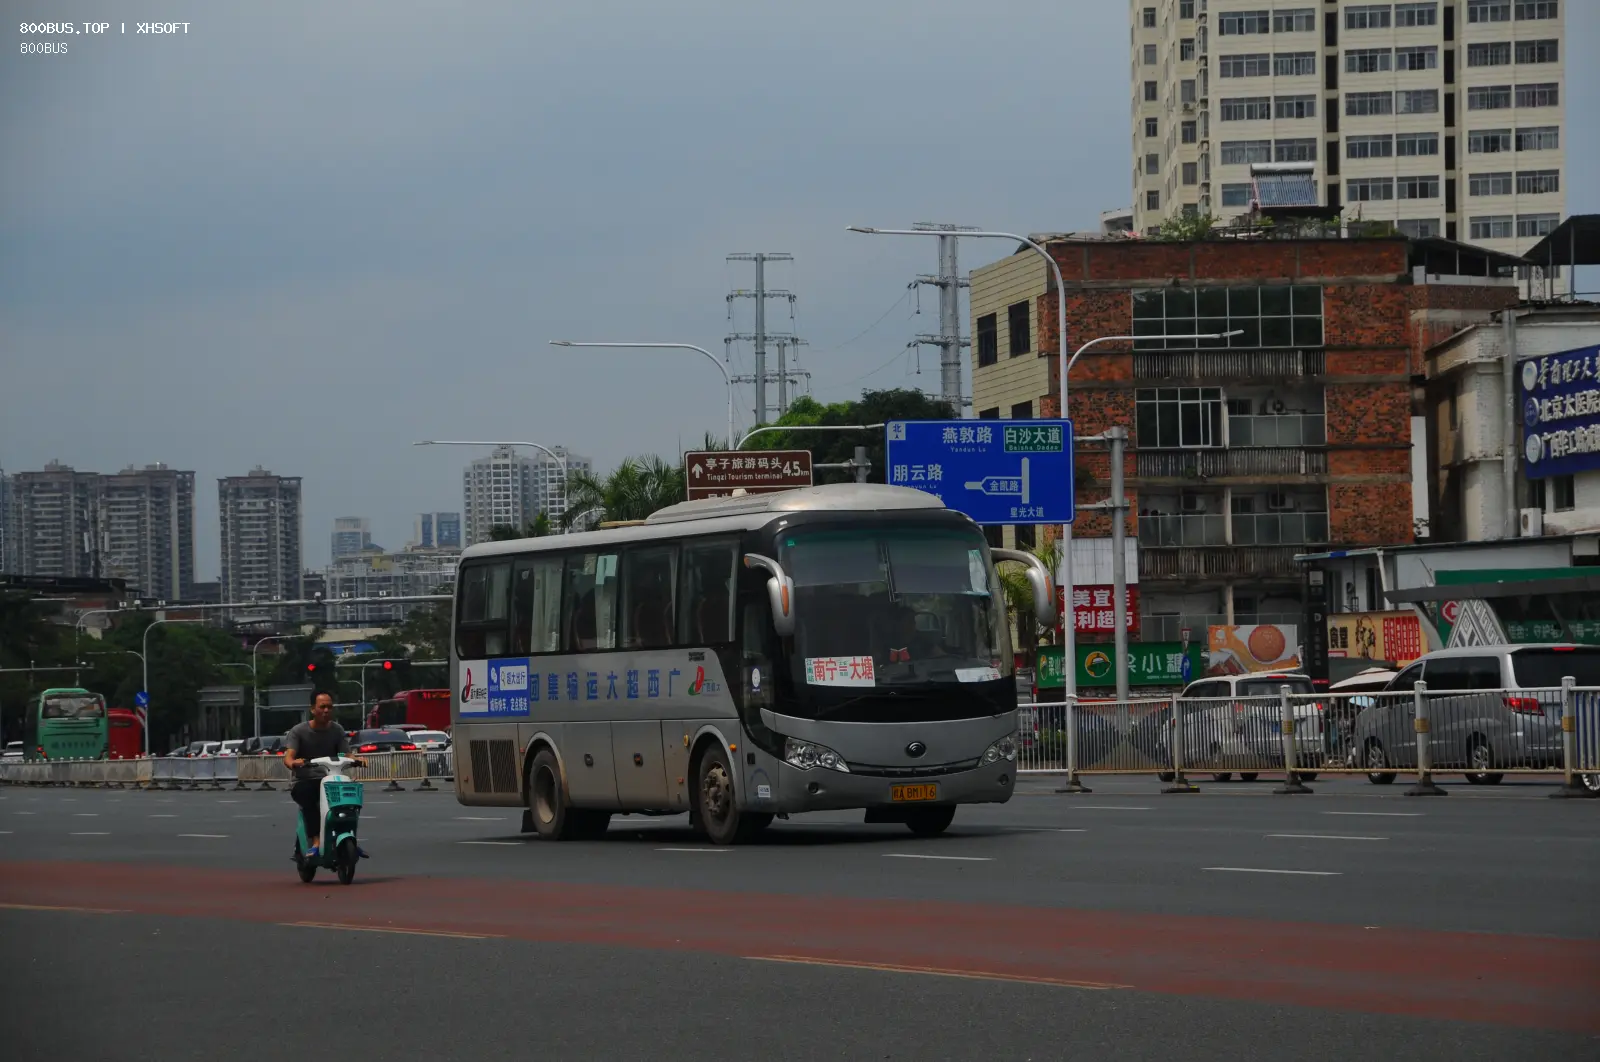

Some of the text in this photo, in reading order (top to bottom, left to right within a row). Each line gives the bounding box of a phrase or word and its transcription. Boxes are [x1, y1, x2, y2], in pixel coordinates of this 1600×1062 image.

[892, 423, 902, 433] 北
[942, 425, 993, 444] 燕敦路
[1005, 427, 1061, 444] 白沙大道
[705, 457, 783, 470] 亭子旅游码头
[728, 473, 754, 481] Tourism
[755, 472, 783, 480] terminal
[893, 463, 944, 482] 朋云路
[1009, 506, 1045, 518] 星光大道
[1072, 588, 1131, 607] 美宜
[813, 656, 874, 682] 南宁 大塘
